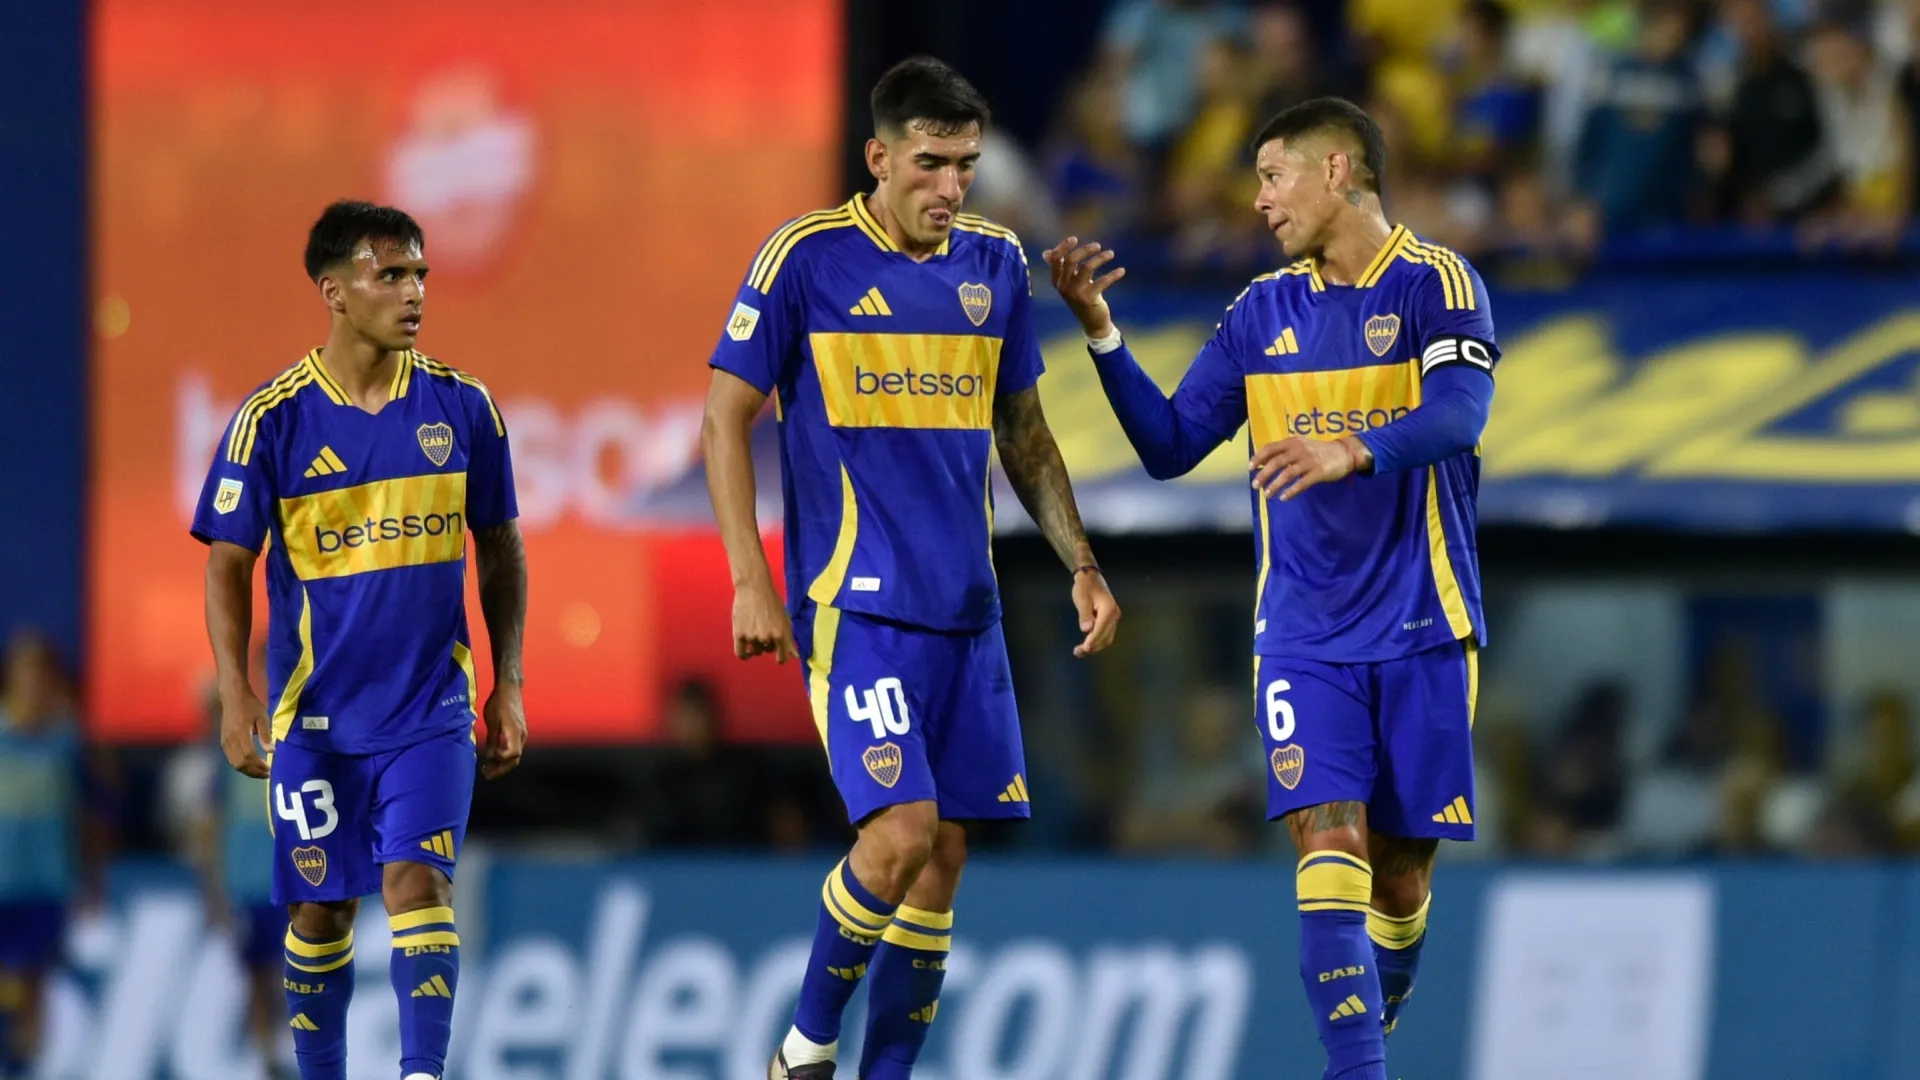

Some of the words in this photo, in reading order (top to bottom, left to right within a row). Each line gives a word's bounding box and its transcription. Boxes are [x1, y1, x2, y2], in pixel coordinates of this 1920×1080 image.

[1368, 328, 1395, 338] CABJ
[855, 365, 984, 398] betsson
[423, 436, 450, 447] CABJ
[315, 512, 463, 553] betsson
[844, 677, 911, 739] 40
[1266, 679, 1296, 742] 6
[870, 756, 898, 771] CABJ
[1275, 758, 1300, 772] CABJ
[275, 779, 339, 841] 43
[298, 857, 323, 868] CABJ
[405, 943, 451, 958] CABJ
[1319, 965, 1365, 983] CABJ
[283, 976, 325, 994] CABJ
